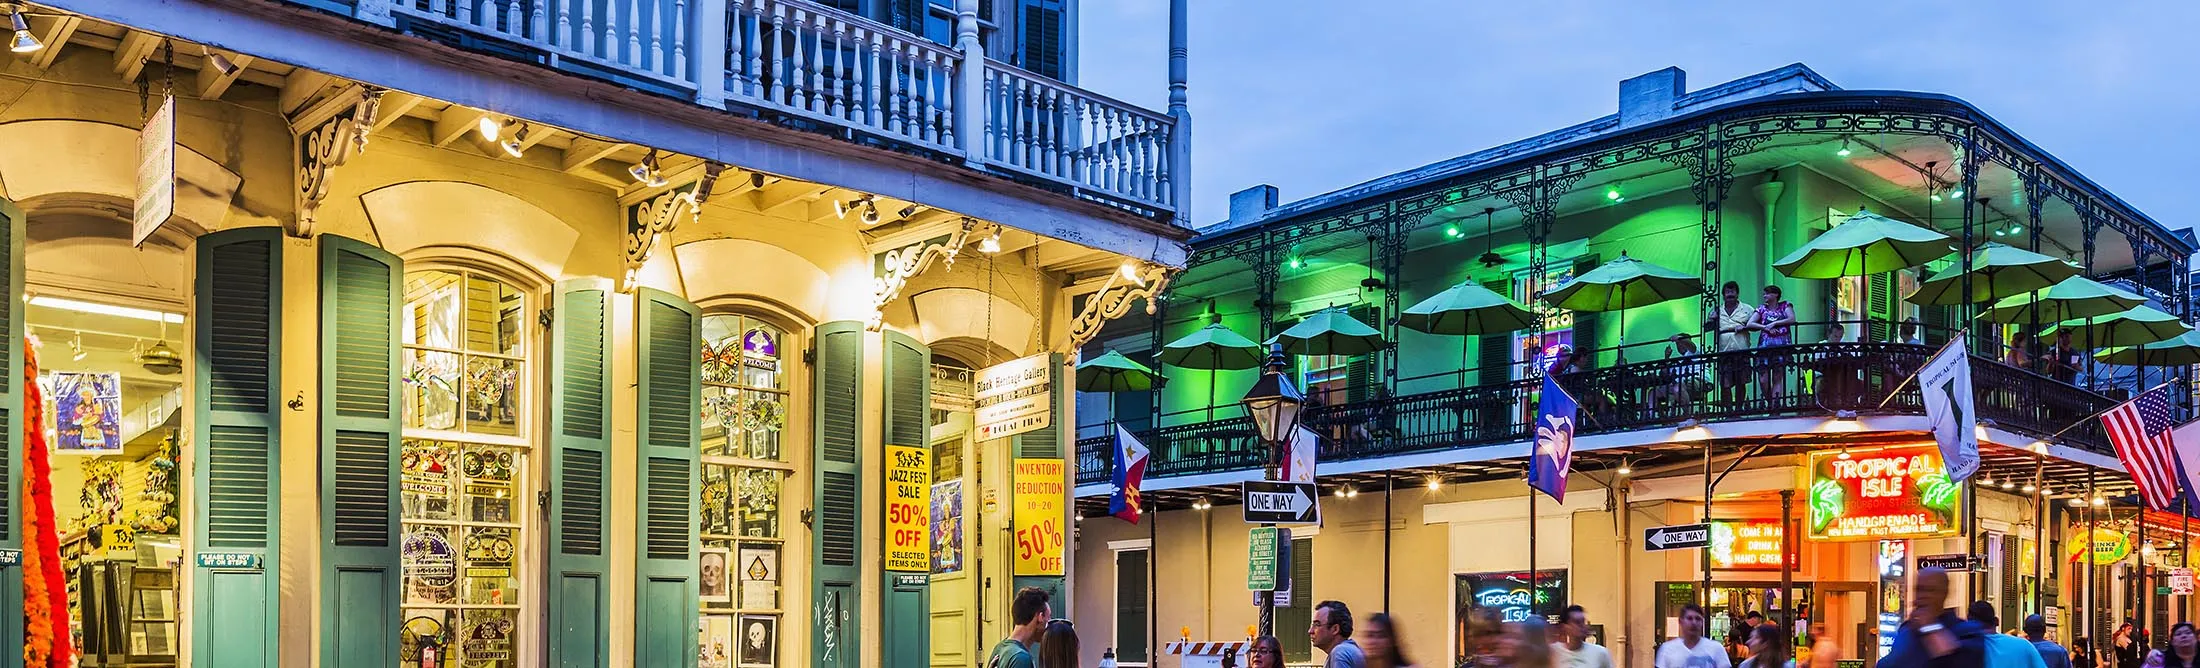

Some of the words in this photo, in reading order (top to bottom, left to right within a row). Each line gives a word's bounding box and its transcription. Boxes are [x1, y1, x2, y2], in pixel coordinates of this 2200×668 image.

[977, 380, 993, 393] Black
[995, 374, 1021, 389] Heritage
[1024, 366, 1047, 381] Gallery
[1016, 463, 1062, 476] INVENTORY
[1832, 455, 1935, 479] TROPICAL
[889, 469, 908, 482] JAZZ
[909, 471, 927, 484] FEST
[898, 485, 920, 499] SALE
[1016, 482, 1062, 495] REDUCTION
[1861, 477, 1903, 498] ISLE
[1251, 494, 1270, 510] ONE
[1272, 494, 1295, 510] WAY
[890, 503, 927, 527] 50%
[1839, 513, 1926, 529] HANDGRENADE
[895, 529, 921, 548] OFF
[1017, 517, 1062, 561] 50%
[1664, 532, 1683, 543] ONE
[1684, 530, 1705, 542] WAY
[1739, 526, 1761, 538] COME
[1763, 526, 1773, 537] IN
[891, 551, 926, 560] SELECTED
[1735, 554, 1757, 564] HAND
[888, 559, 909, 567] ITEMS
[910, 559, 928, 568] ONLY
[1040, 557, 1062, 572] OFF
[1920, 560, 1964, 569] Orleans
[1476, 588, 1531, 606] TROPICAL
